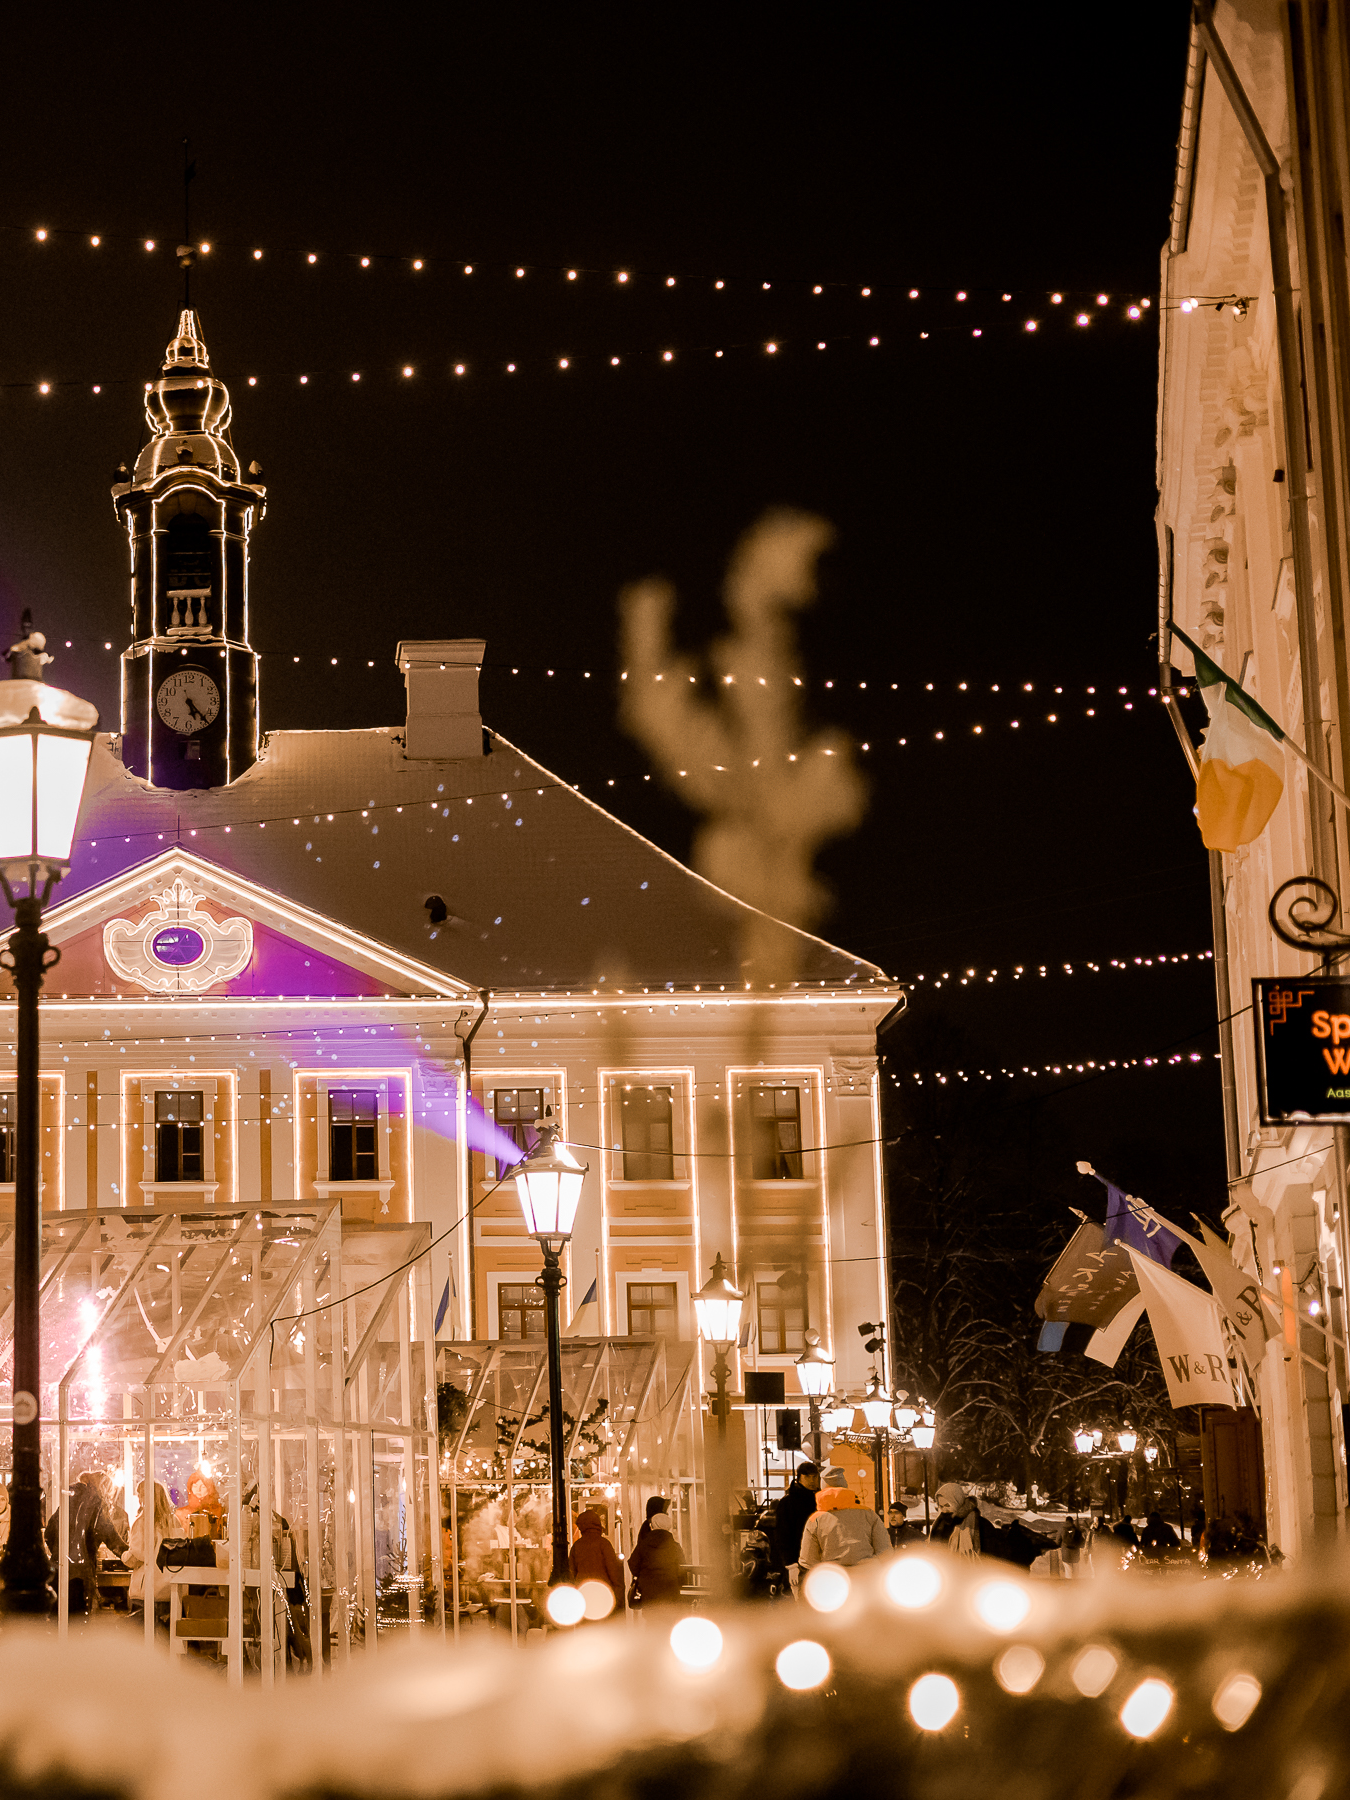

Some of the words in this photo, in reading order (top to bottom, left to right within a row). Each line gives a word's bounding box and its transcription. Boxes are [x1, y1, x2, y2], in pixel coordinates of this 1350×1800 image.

[174, 679, 182, 687] 11
[184, 675, 194, 683] 12
[199, 676, 205, 687] 1
[165, 688, 176, 696] 10
[207, 686, 213, 695] 2
[161, 697, 168, 706] 9
[210, 697, 217, 706] 3
[164, 708, 171, 717] 8
[207, 708, 214, 716] 4
[173, 716, 180, 727] 7
[185, 720, 192, 729] 6
[1311, 1010, 1350, 1045] Sp
[1321, 1047, 1350, 1075] W
